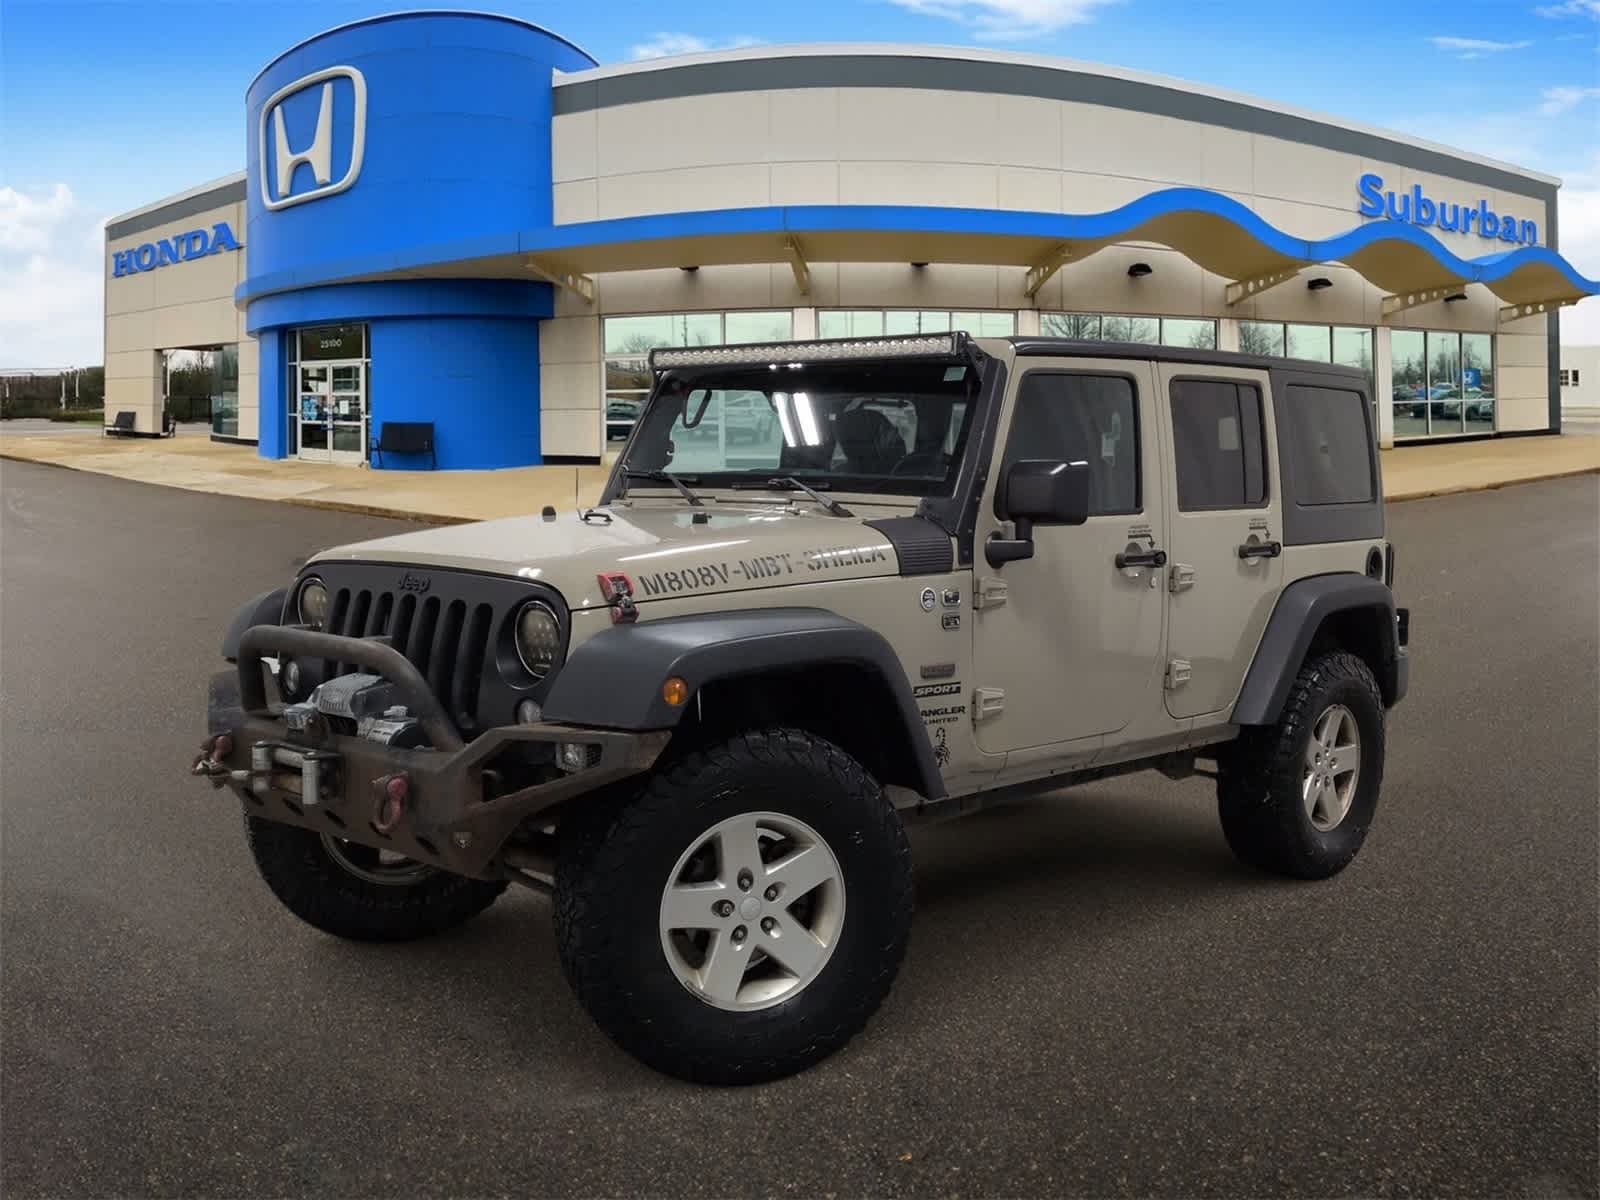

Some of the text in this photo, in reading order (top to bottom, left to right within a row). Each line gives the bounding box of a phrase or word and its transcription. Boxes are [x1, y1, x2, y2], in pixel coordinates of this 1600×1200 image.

[1358, 173, 1538, 246] Suburban
[112, 221, 240, 278] HONDA
[398, 574, 431, 594] Jeep
[915, 683, 960, 697] SPORT
[920, 705, 966, 717] ANGLER
